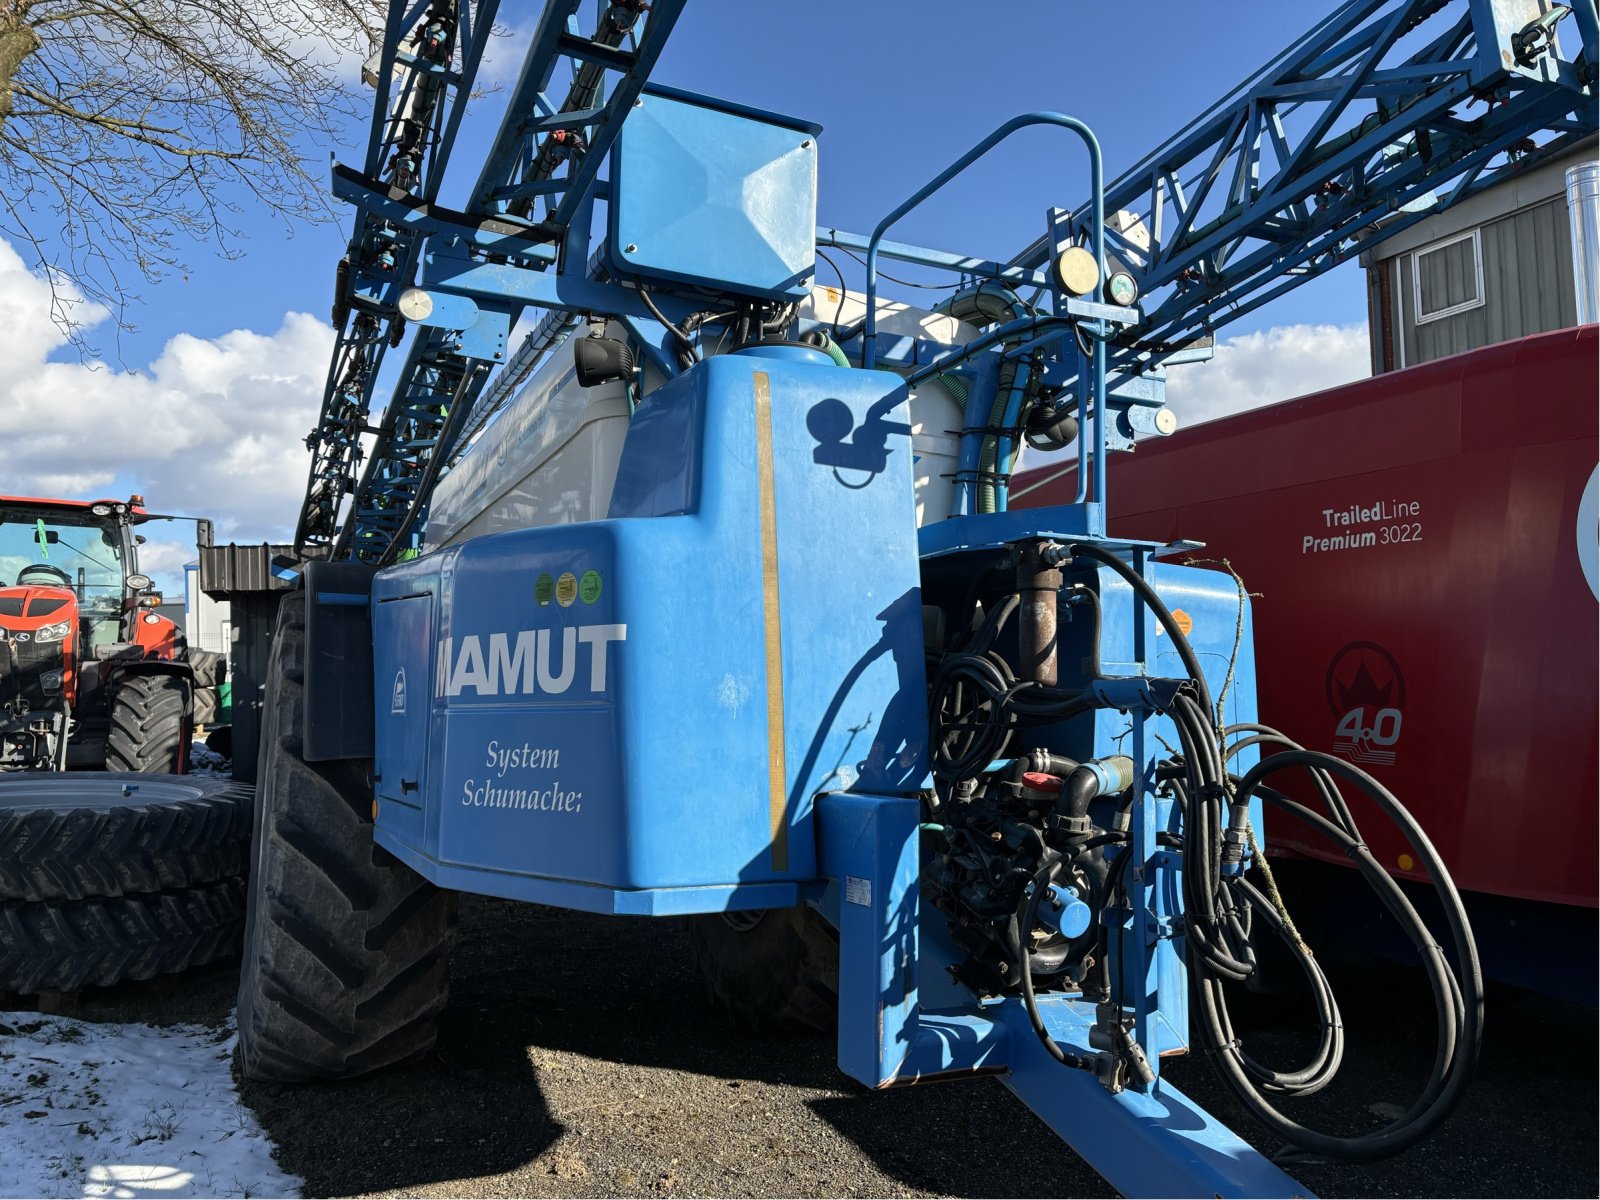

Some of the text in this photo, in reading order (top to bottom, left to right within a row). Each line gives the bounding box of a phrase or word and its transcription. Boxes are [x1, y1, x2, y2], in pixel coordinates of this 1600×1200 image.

[1302, 522, 1423, 554] Premium 3022
[435, 623, 627, 698] MAMUT
[1335, 706, 1403, 746] 4.0
[486, 740, 560, 778] System
